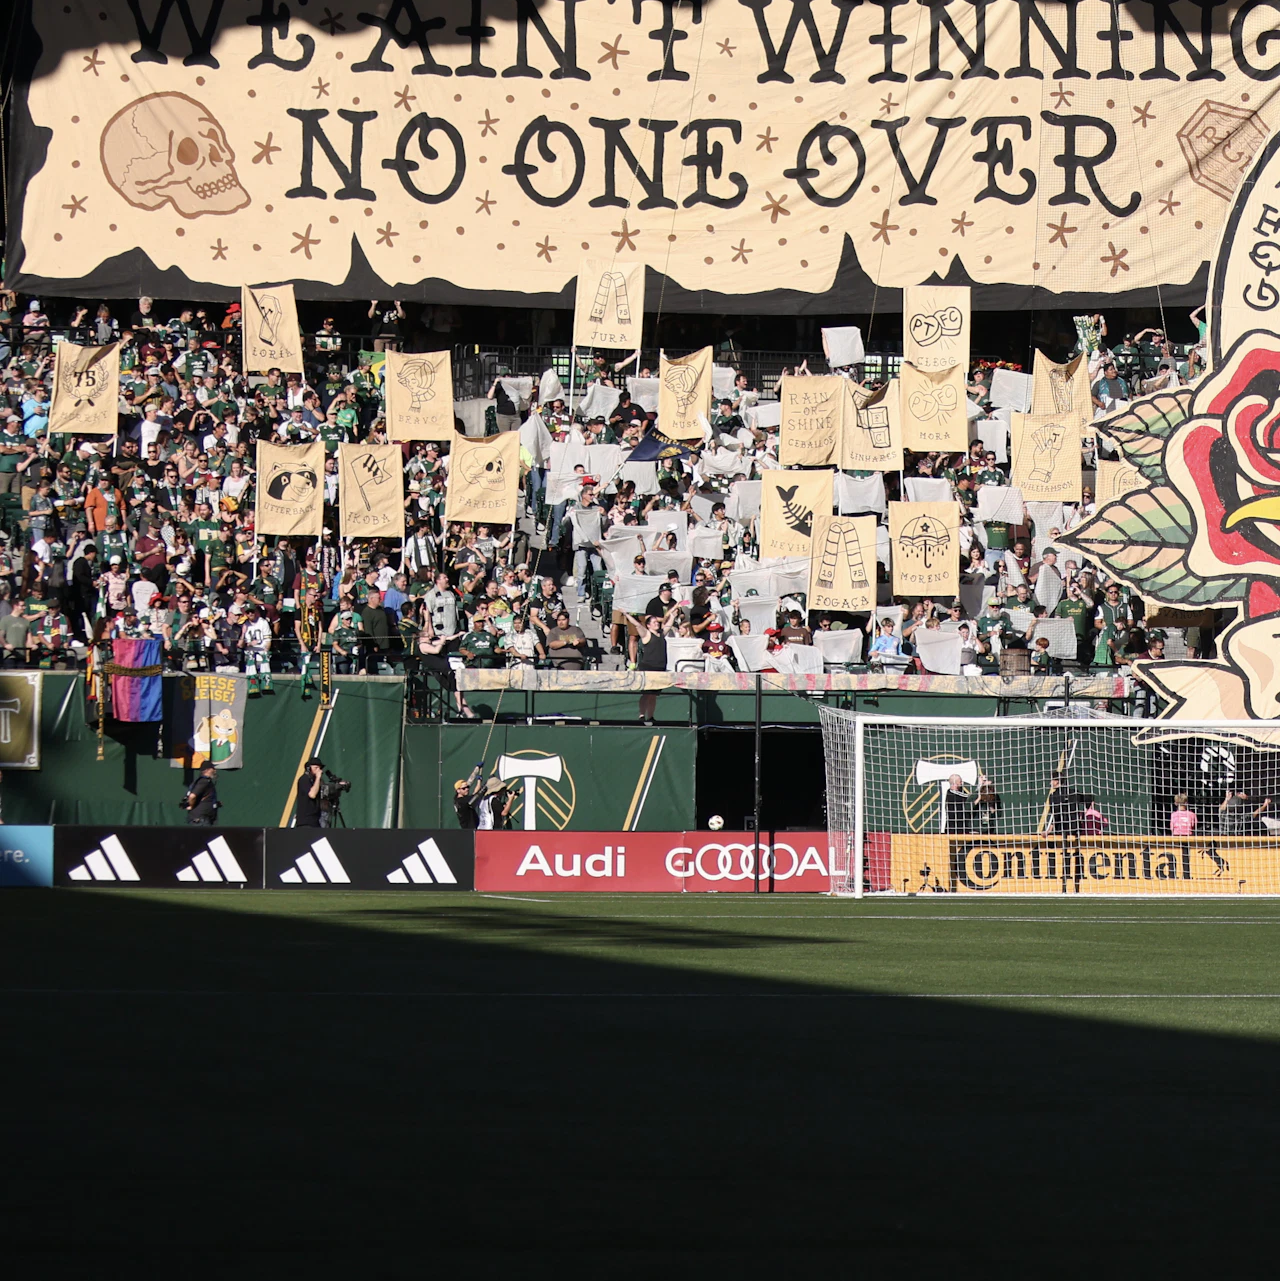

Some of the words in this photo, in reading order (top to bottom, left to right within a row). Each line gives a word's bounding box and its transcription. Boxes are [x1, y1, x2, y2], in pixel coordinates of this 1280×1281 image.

[285, 107, 467, 205] NO
[501, 114, 749, 211] ONE
[783, 110, 1142, 217] OVER
[590, 331, 628, 344] JURA
[916, 356, 957, 368] CLEGG
[73, 370, 96, 388] 75
[788, 391, 829, 406] RAIN
[398, 414, 438, 425] BRAVO
[787, 416, 833, 431] SHINE
[919, 431, 951, 441] MORA
[787, 437, 834, 449] CEBALLOS
[1020, 480, 1074, 493] WILLIAMSON
[458, 496, 508, 509] PAREDES
[263, 503, 316, 517] UTTERBACK
[900, 571, 950, 584] MORENO
[814, 594, 870, 610] FOGAÇA
[516, 846, 627, 878] Audi
[952, 841, 1192, 891] Continental
